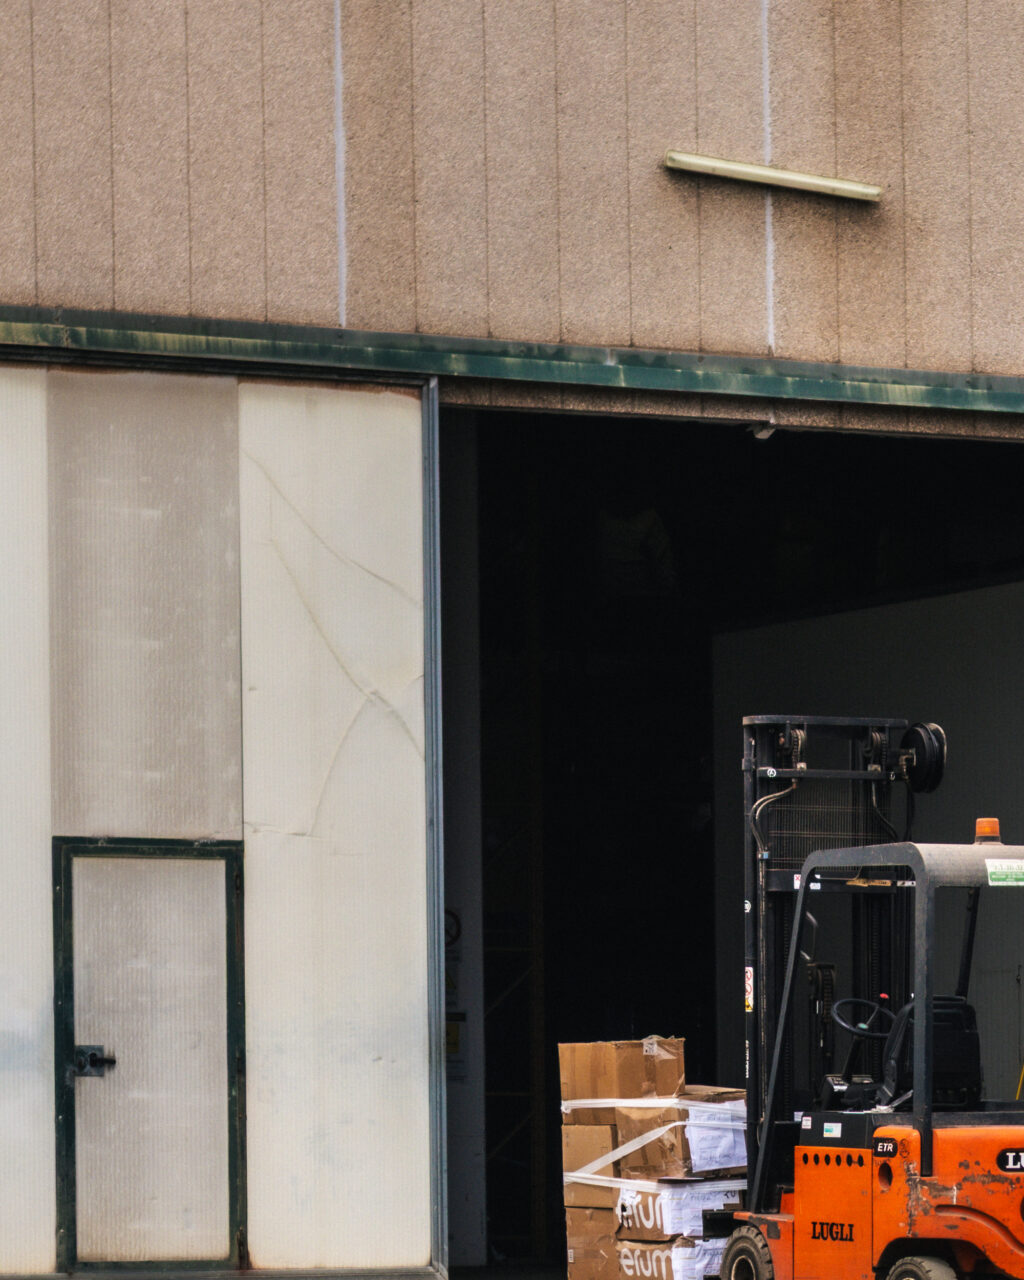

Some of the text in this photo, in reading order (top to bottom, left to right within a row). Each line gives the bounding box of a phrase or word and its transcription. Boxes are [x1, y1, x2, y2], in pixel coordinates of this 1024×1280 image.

[878, 1142, 893, 1151] ETR
[811, 1221, 854, 1242] LUGLI
[620, 1247, 673, 1280] erum
